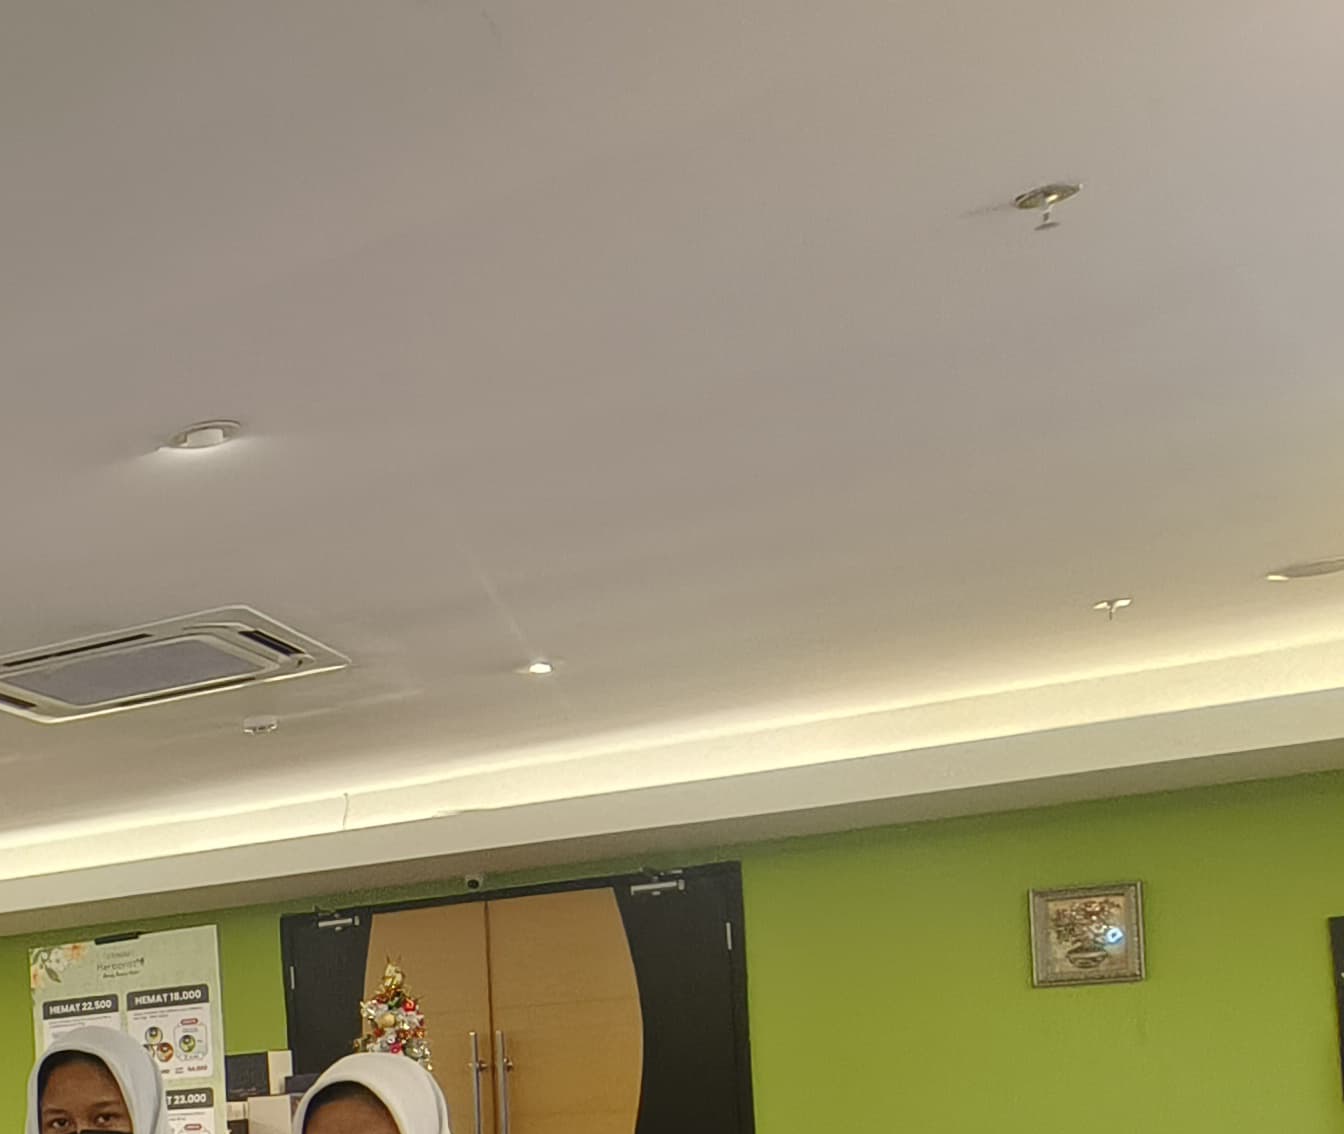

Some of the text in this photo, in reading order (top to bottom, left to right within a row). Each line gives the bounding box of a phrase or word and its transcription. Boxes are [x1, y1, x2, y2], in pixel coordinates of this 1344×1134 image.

[135, 993, 169, 1006] HEMAT
[49, 999, 112, 1016] HEMAT 22.500
